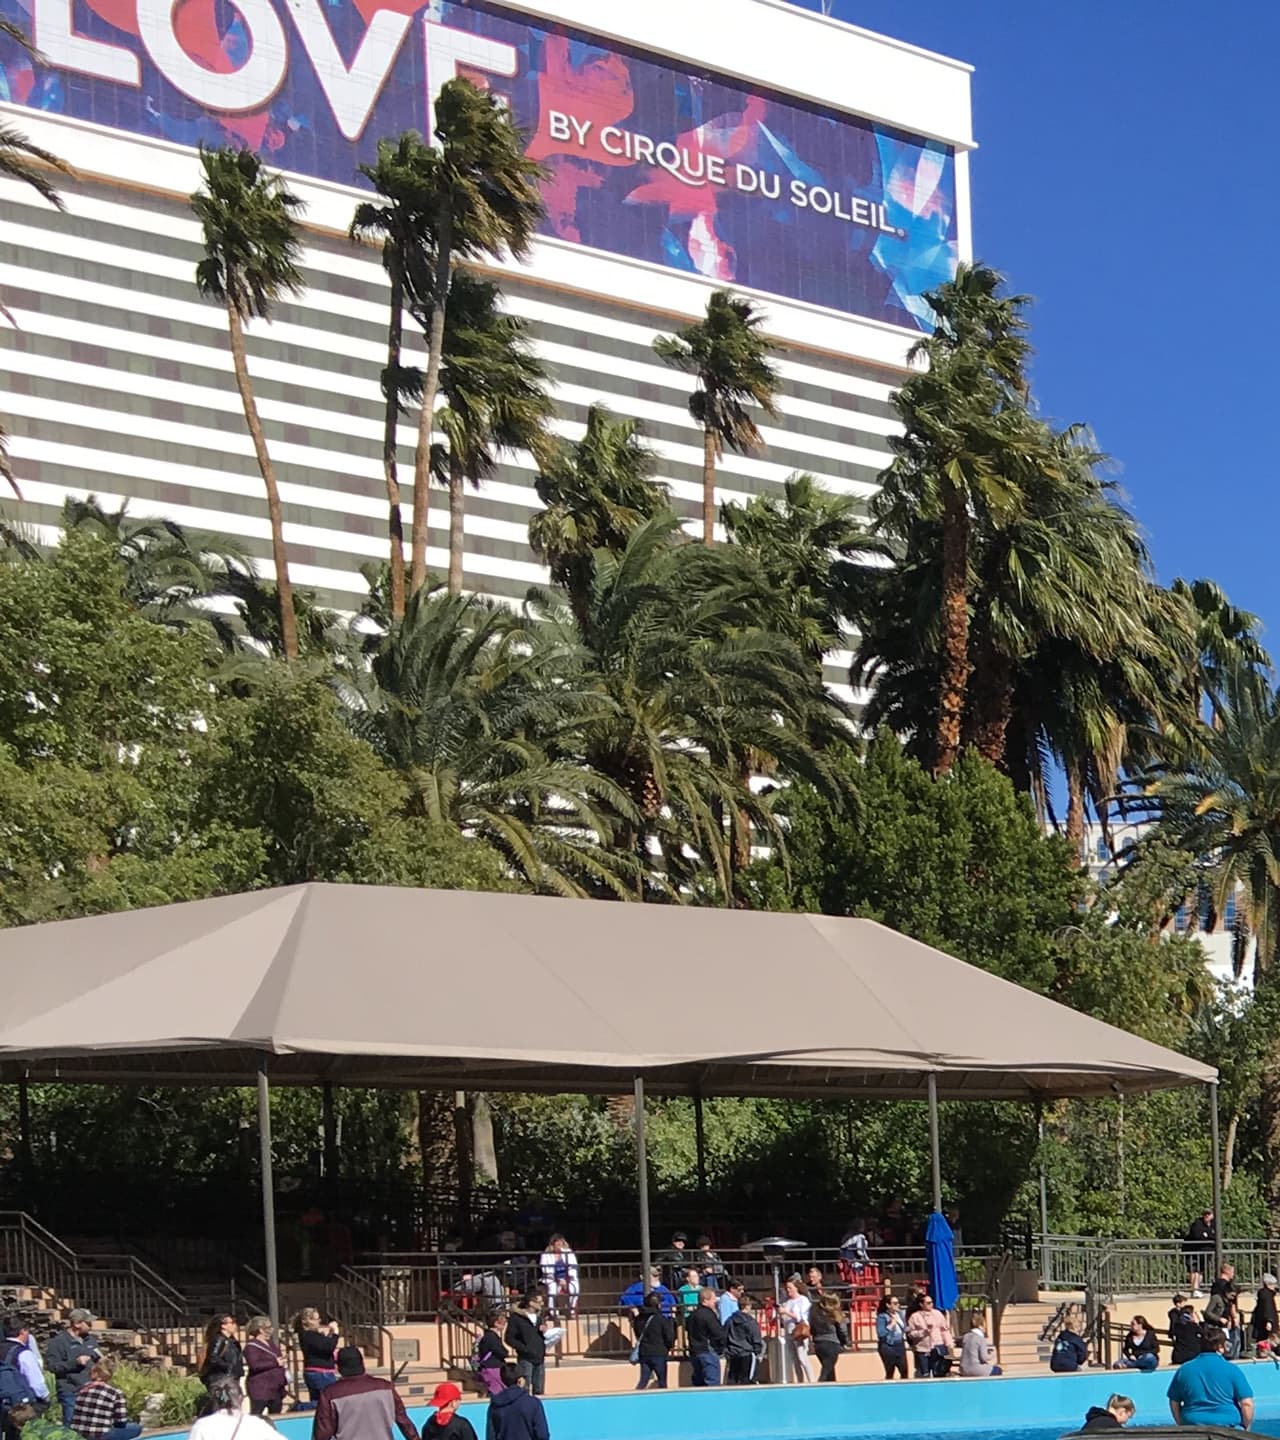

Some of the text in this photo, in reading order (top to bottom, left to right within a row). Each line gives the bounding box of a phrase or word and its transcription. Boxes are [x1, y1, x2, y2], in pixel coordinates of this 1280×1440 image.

[548, 110, 591, 146] BY
[600, 126, 727, 186] CIRQUE
[736, 165, 781, 200] DU
